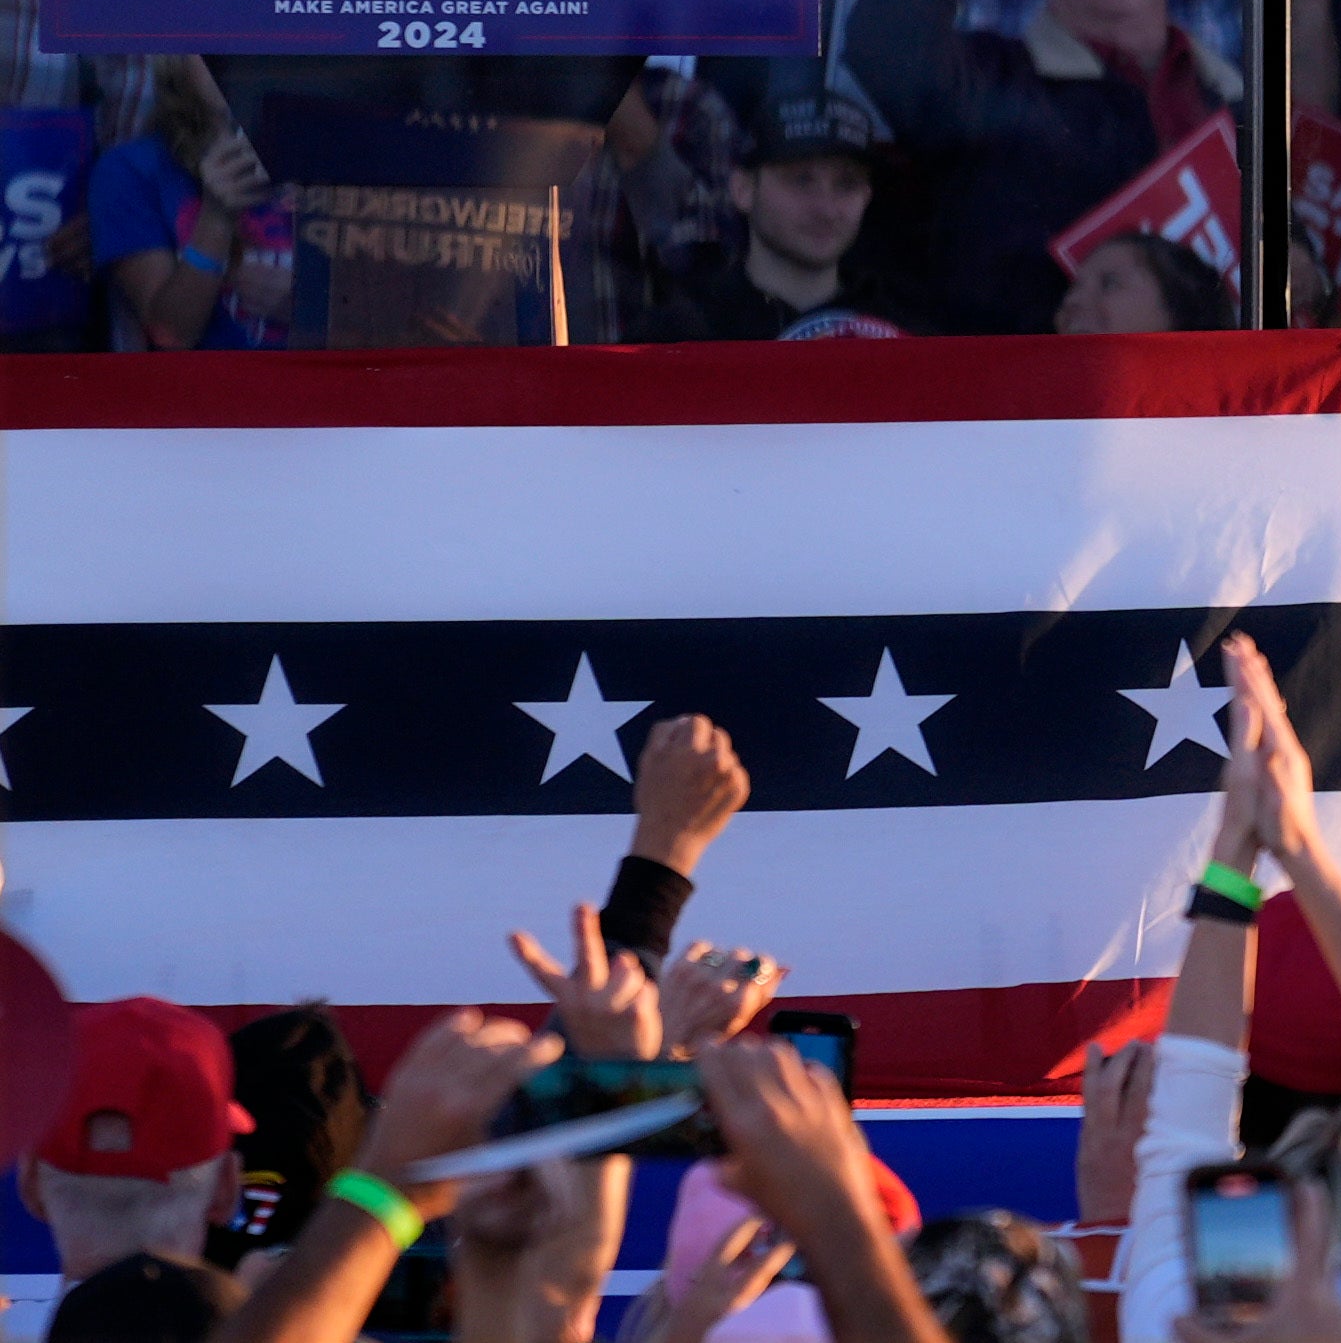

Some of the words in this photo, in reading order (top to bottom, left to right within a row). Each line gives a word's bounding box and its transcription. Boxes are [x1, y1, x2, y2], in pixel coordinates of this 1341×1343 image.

[274, 0, 333, 16] MAKE
[340, 0, 435, 16] AMERICA
[441, 0, 508, 16] GREAT
[515, 0, 589, 17] AGAIN!
[376, 21, 487, 50] 2024
